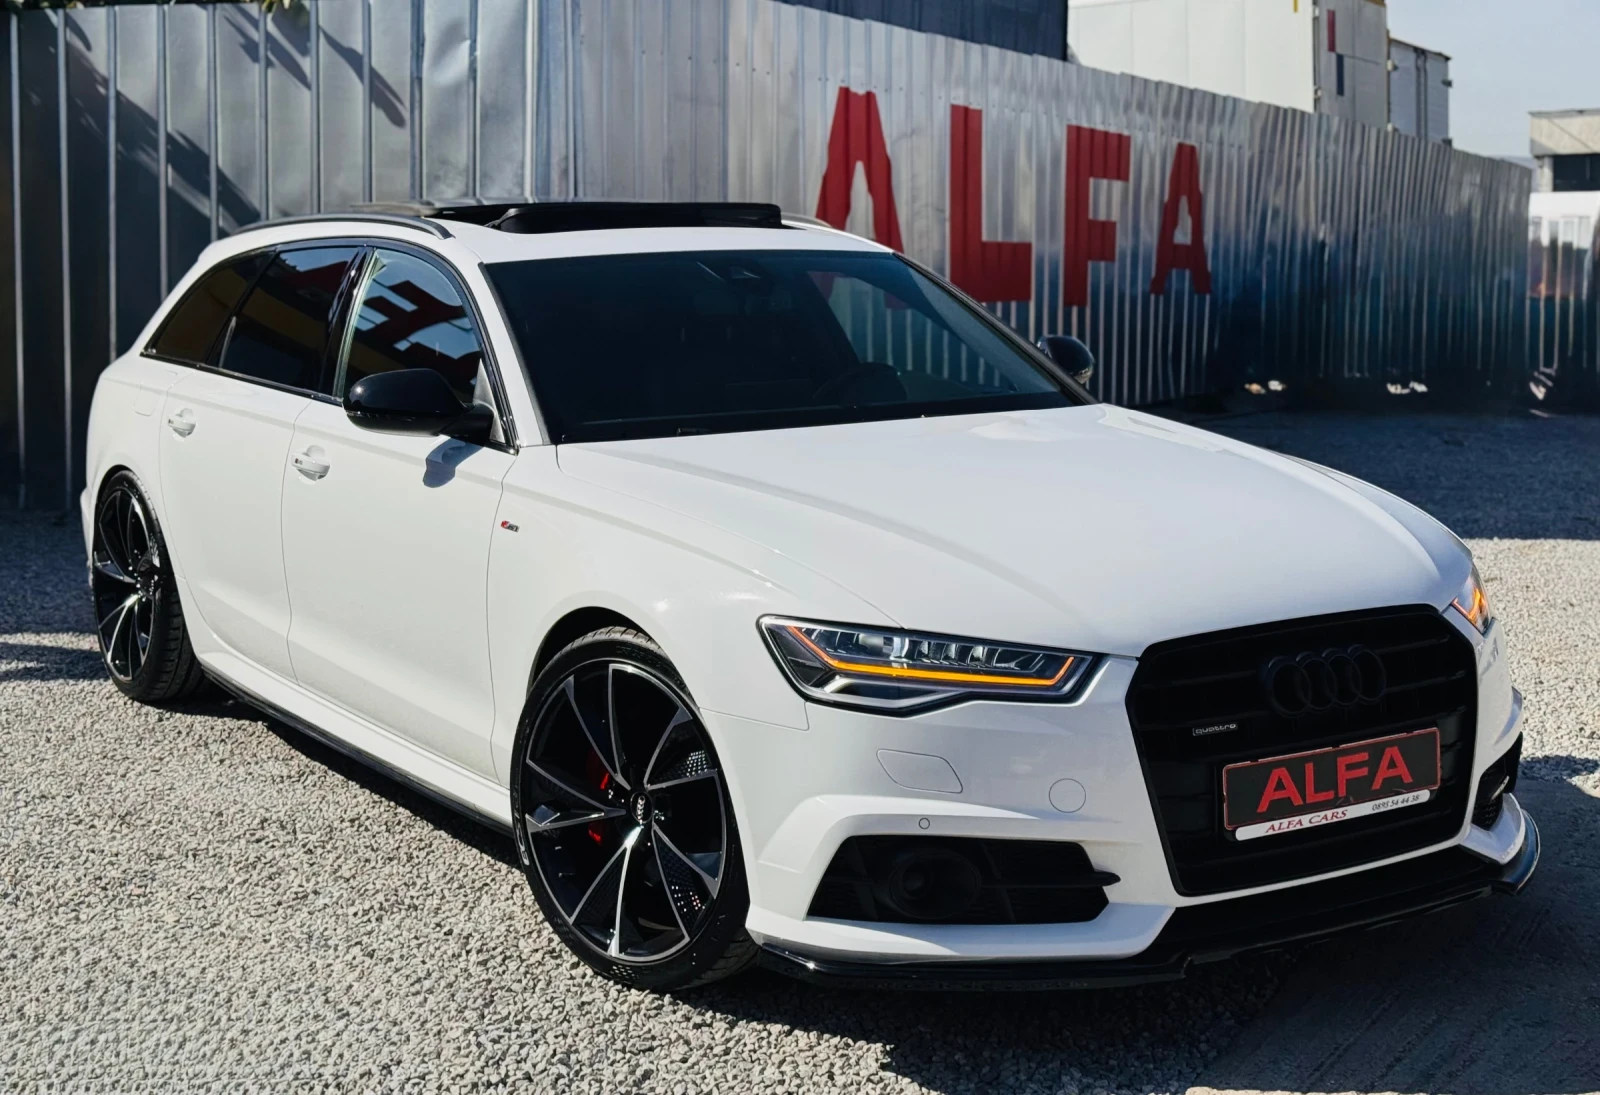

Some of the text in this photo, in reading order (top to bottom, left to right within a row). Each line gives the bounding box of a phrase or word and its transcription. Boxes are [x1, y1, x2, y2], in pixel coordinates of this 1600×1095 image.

[815, 86, 1212, 307] ALFA
[1194, 723, 1237, 735] quattro
[1256, 746, 1413, 813] ALFA
[1265, 809, 1348, 833] ALFA CARS
